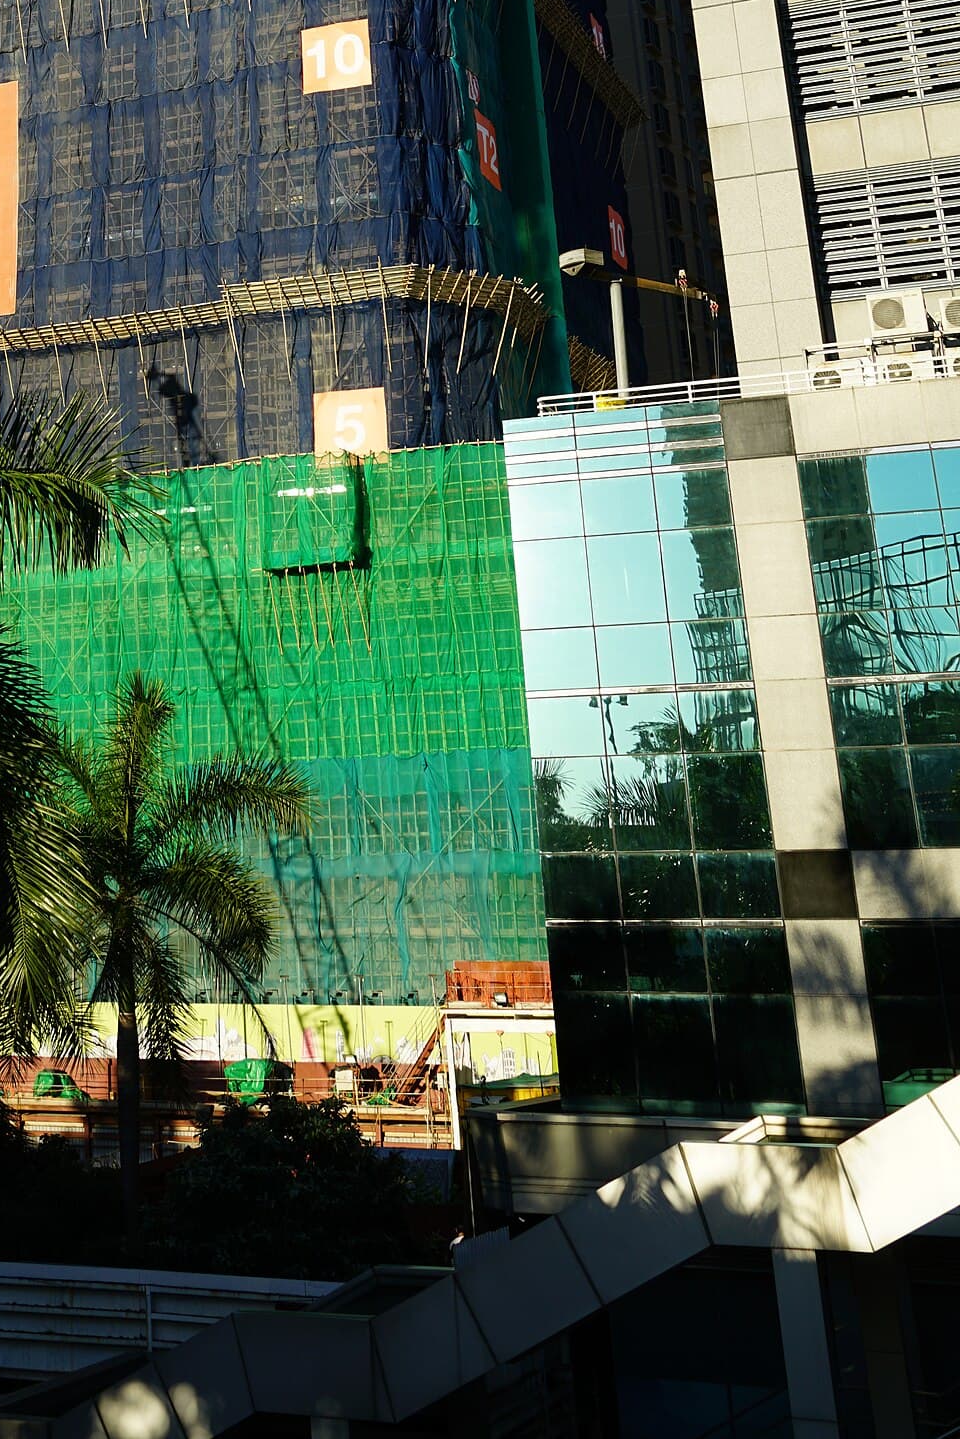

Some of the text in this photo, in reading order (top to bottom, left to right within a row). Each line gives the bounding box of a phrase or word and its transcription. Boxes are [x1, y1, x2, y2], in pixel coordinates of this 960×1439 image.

[306, 33, 365, 79] 10
[476, 122, 500, 177] T2
[609, 218, 626, 258] 10
[332, 404, 366, 453] 5
